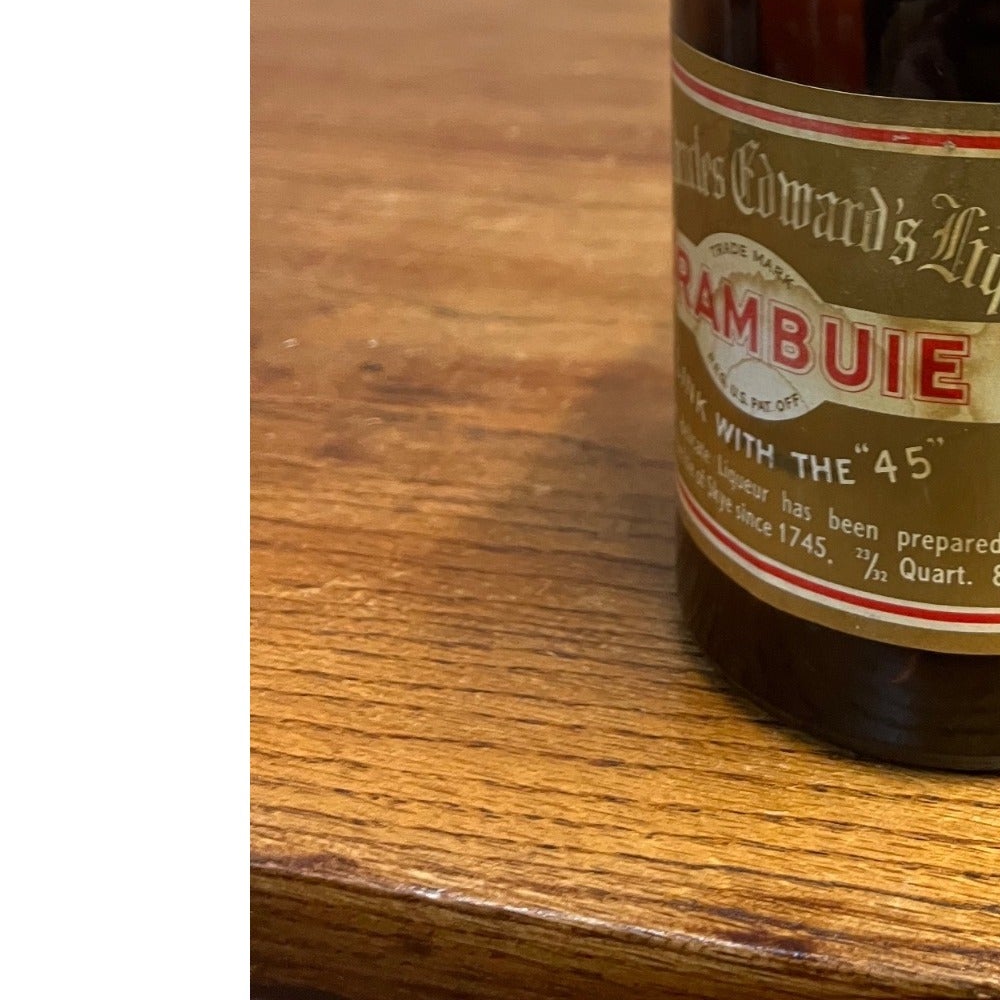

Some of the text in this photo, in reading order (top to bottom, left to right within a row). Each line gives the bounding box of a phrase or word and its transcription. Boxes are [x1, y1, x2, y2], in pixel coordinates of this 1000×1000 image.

[731, 139, 924, 266] Edward's
[674, 246, 971, 407] RAMBUIE
[715, 412, 775, 470] WITH
[791, 451, 855, 485] THE
[735, 502, 773, 537] since
[778, 522, 834, 565] 1745.
[899, 557, 973, 585] Quart.
[782, 491, 812, 521] has
[828, 508, 879, 541] been
